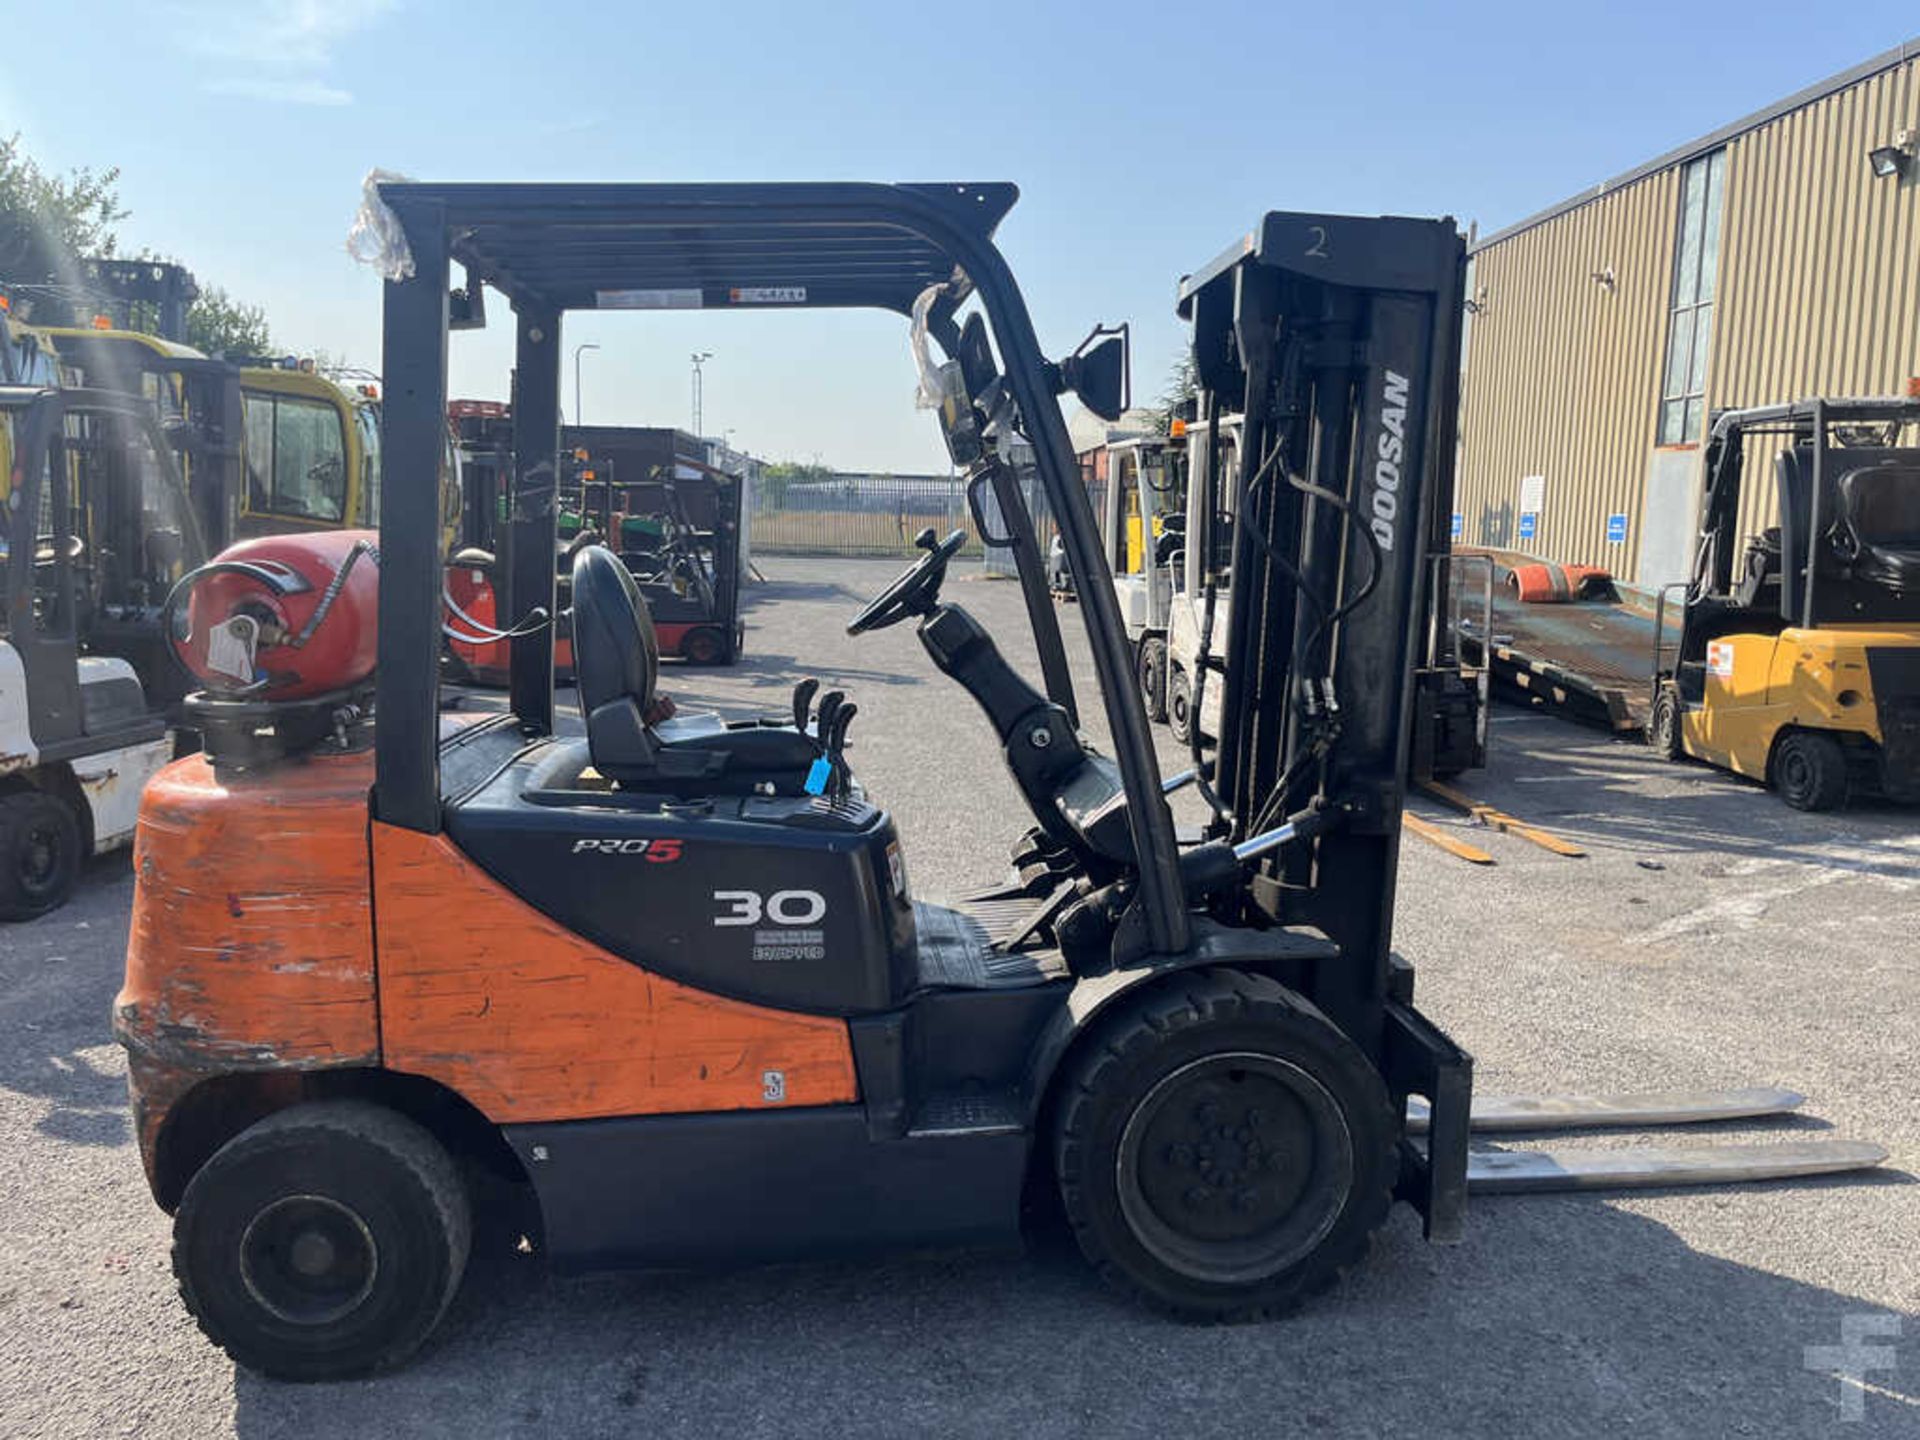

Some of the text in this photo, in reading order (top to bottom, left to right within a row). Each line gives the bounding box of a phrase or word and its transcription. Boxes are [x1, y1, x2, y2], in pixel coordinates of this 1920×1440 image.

[1305, 226, 1328, 258] 2
[1371, 370, 1410, 551] DOOSAN
[714, 890, 826, 925] 30
